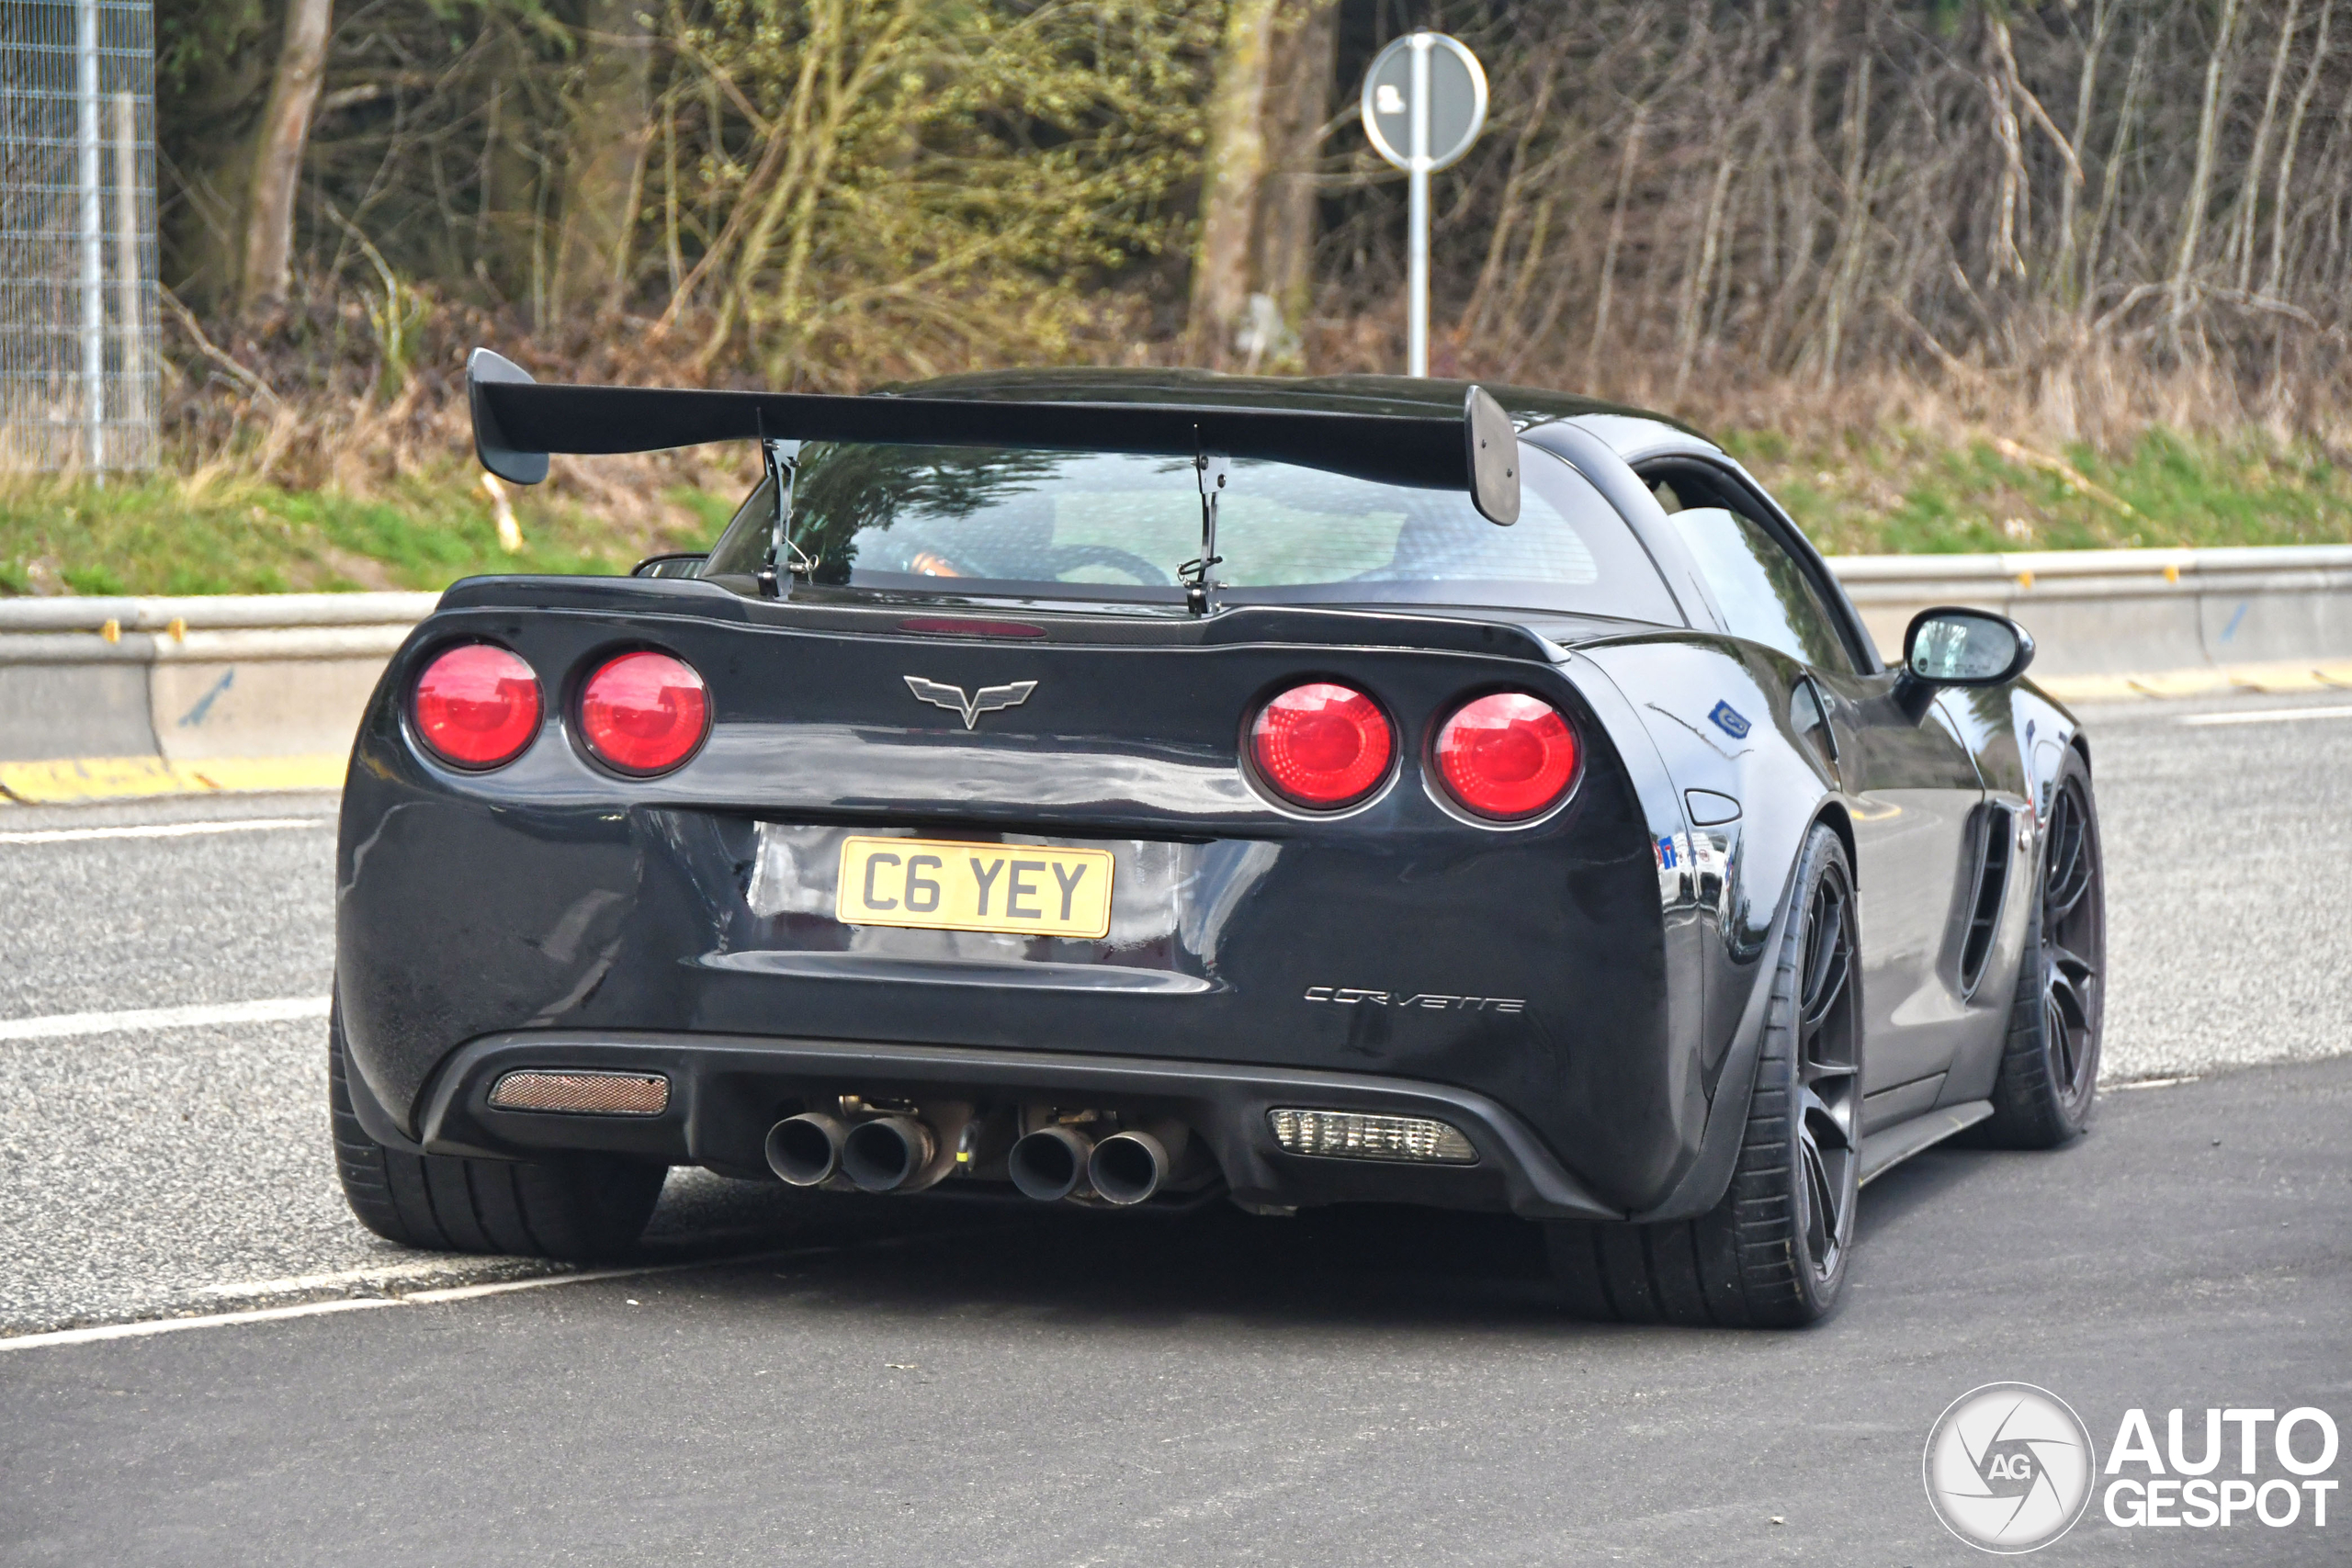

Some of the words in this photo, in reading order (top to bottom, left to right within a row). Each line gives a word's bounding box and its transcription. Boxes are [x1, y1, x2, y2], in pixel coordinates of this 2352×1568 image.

[864, 853, 943, 912] C6
[969, 857, 1088, 921] YEY
[1303, 986, 1528, 1013] CORVETTE
